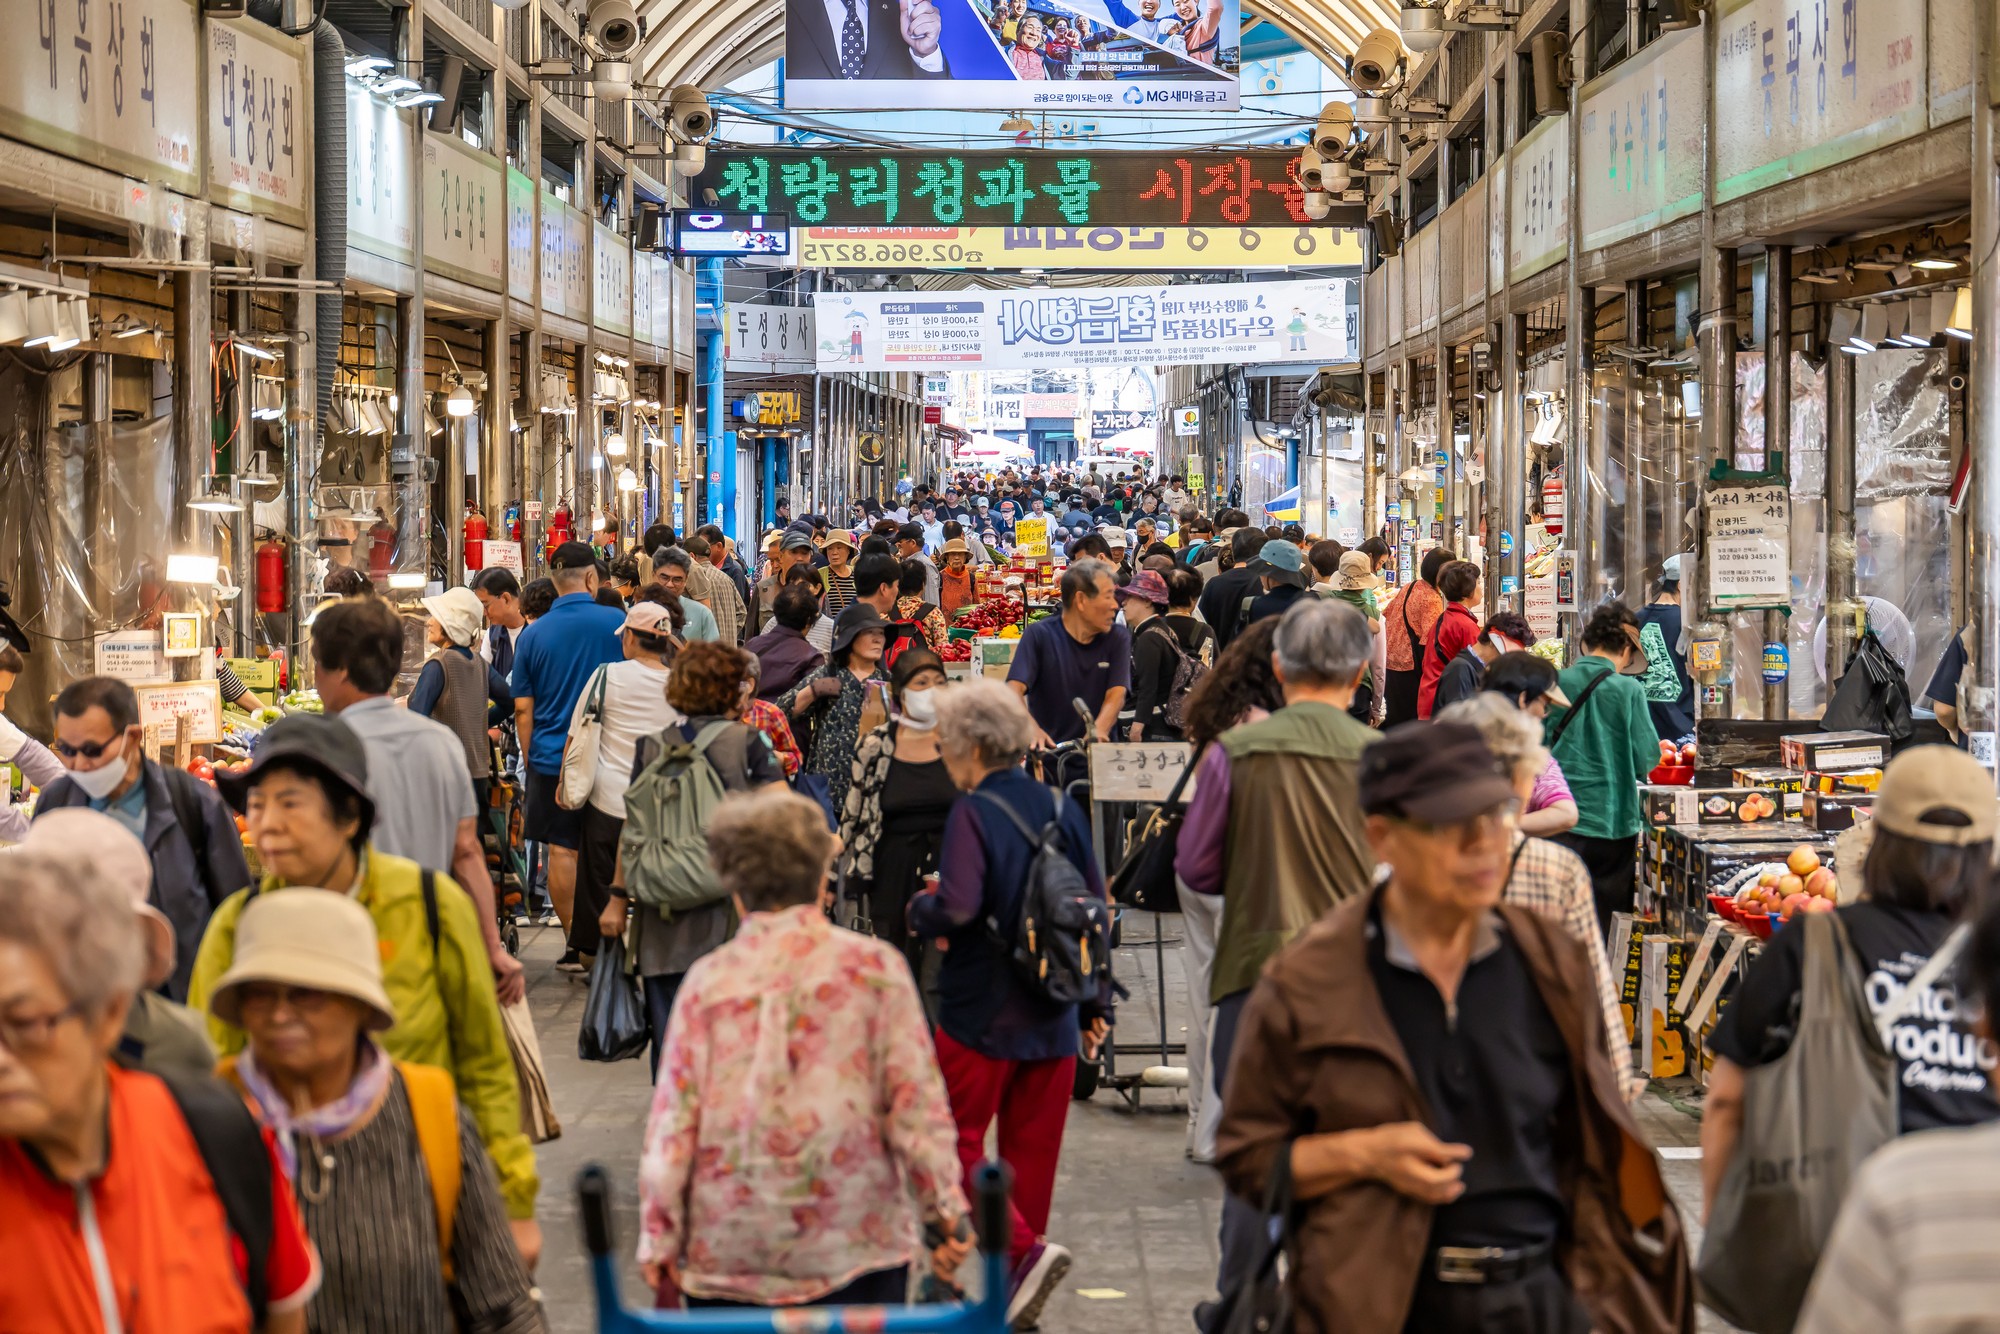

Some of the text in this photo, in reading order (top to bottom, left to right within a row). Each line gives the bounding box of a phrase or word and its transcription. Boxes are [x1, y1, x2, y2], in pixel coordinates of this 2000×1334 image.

[1034, 93, 1064, 103] 금융으로
[1065, 93, 1081, 103] 힘이
[1097, 93, 1113, 103] 이웃
[221, 59, 294, 178] 대청상회
[1036, 120, 1100, 144] 출입구
[737, 311, 808, 351] 두성상사
[1092, 414, 1128, 429] 노가리
[1710, 492, 1740, 505] 서울시
[1763, 505, 1784, 518] 사용
[1716, 516, 1748, 527] 신용카드
